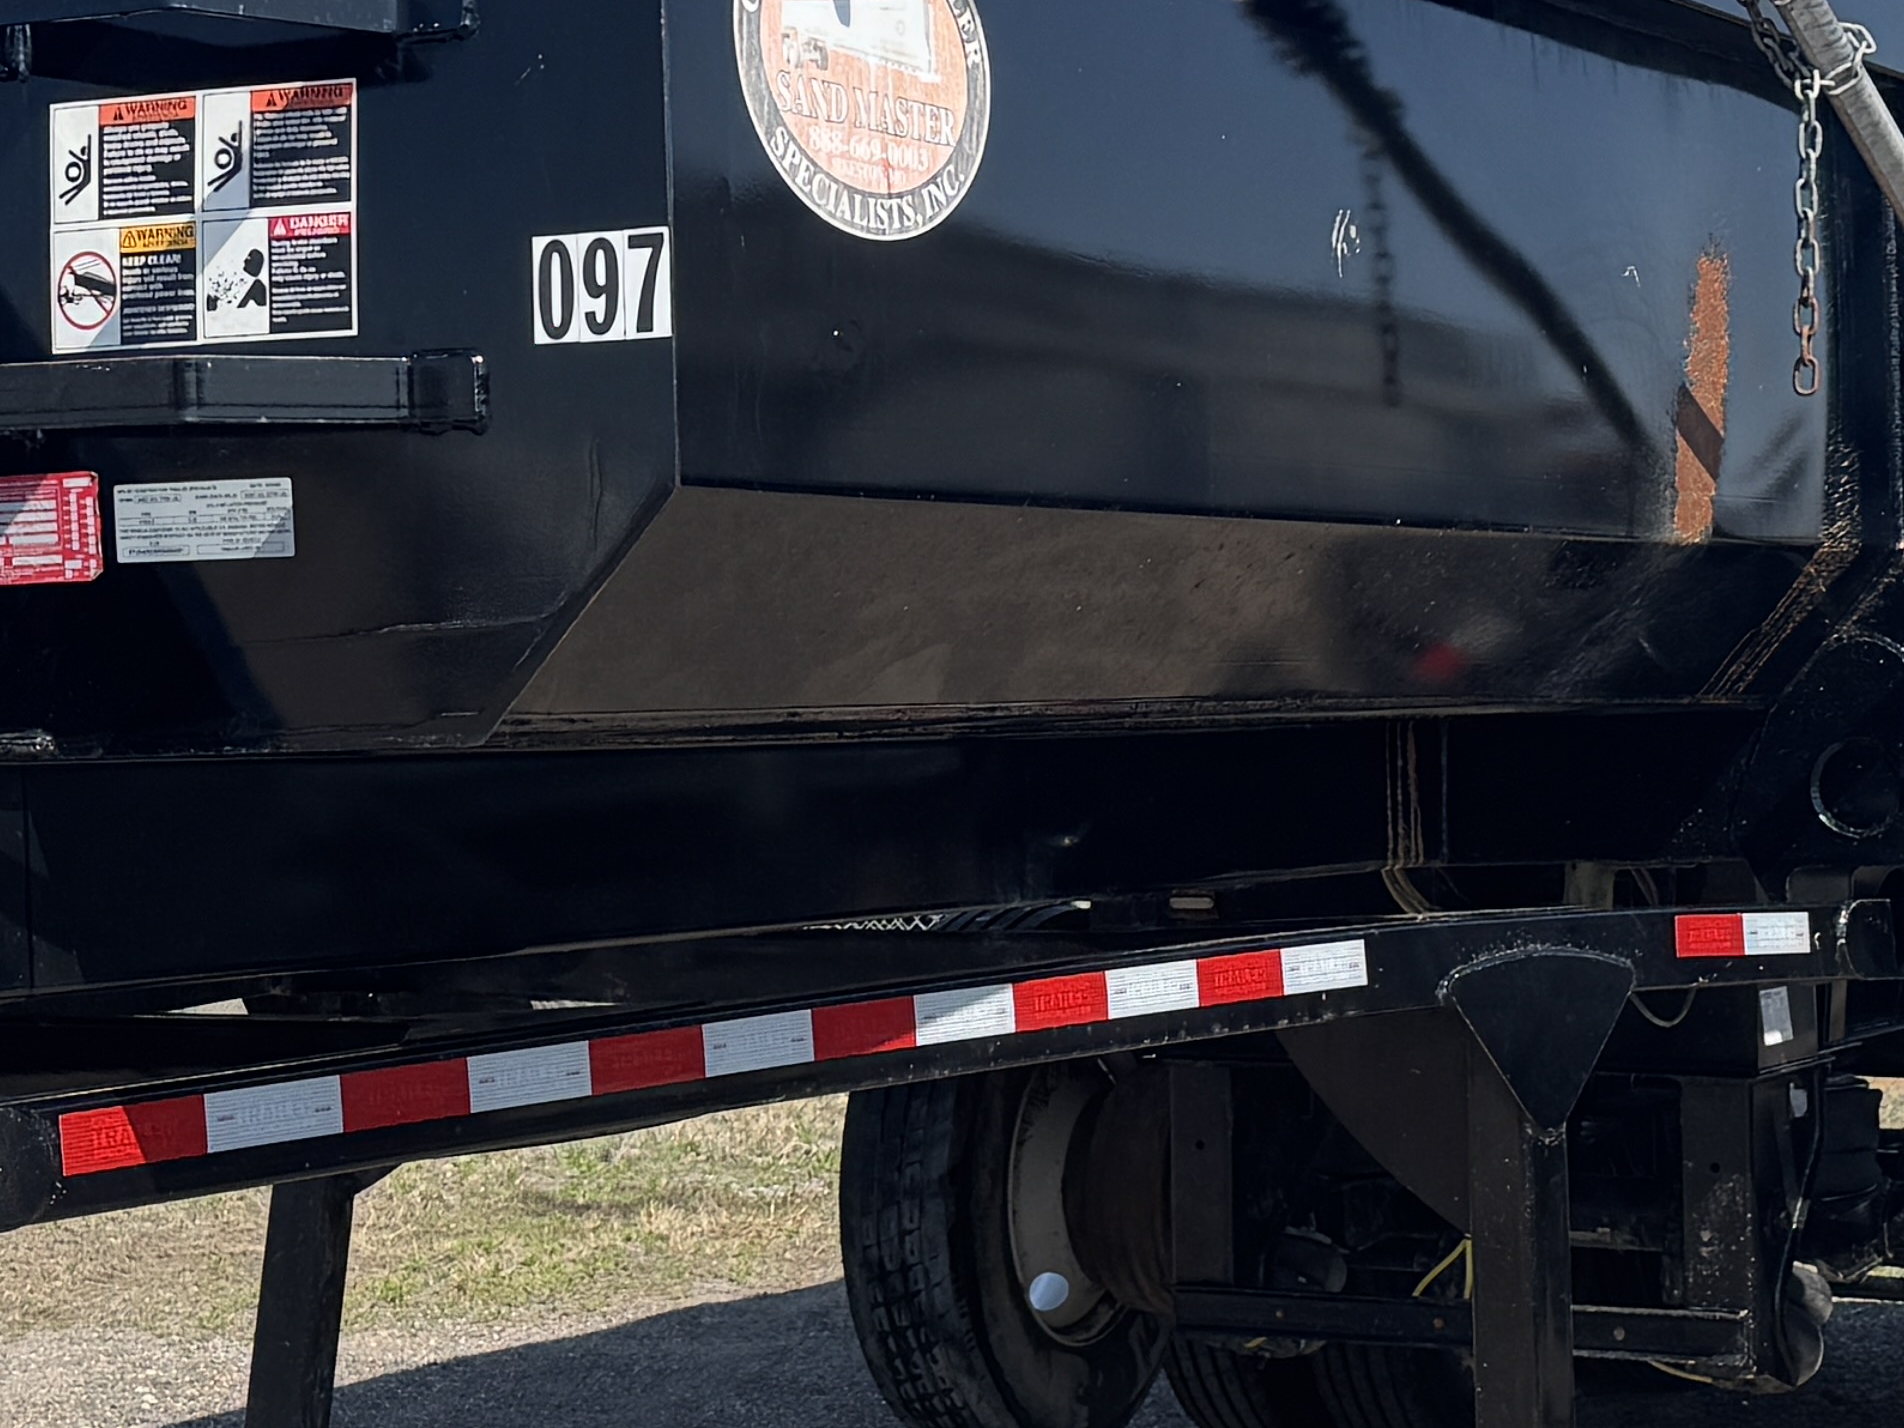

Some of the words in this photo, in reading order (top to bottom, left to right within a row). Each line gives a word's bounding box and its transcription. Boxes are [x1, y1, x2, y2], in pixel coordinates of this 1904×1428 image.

[125, 99, 187, 115] WARNING
[776, 70, 849, 123] SAND
[853, 87, 957, 147] MASTER
[771, 126, 923, 230] SPECIALISTS,
[922, 164, 965, 218] INC.
[136, 224, 194, 241] WARNING
[538, 232, 664, 340] 097
